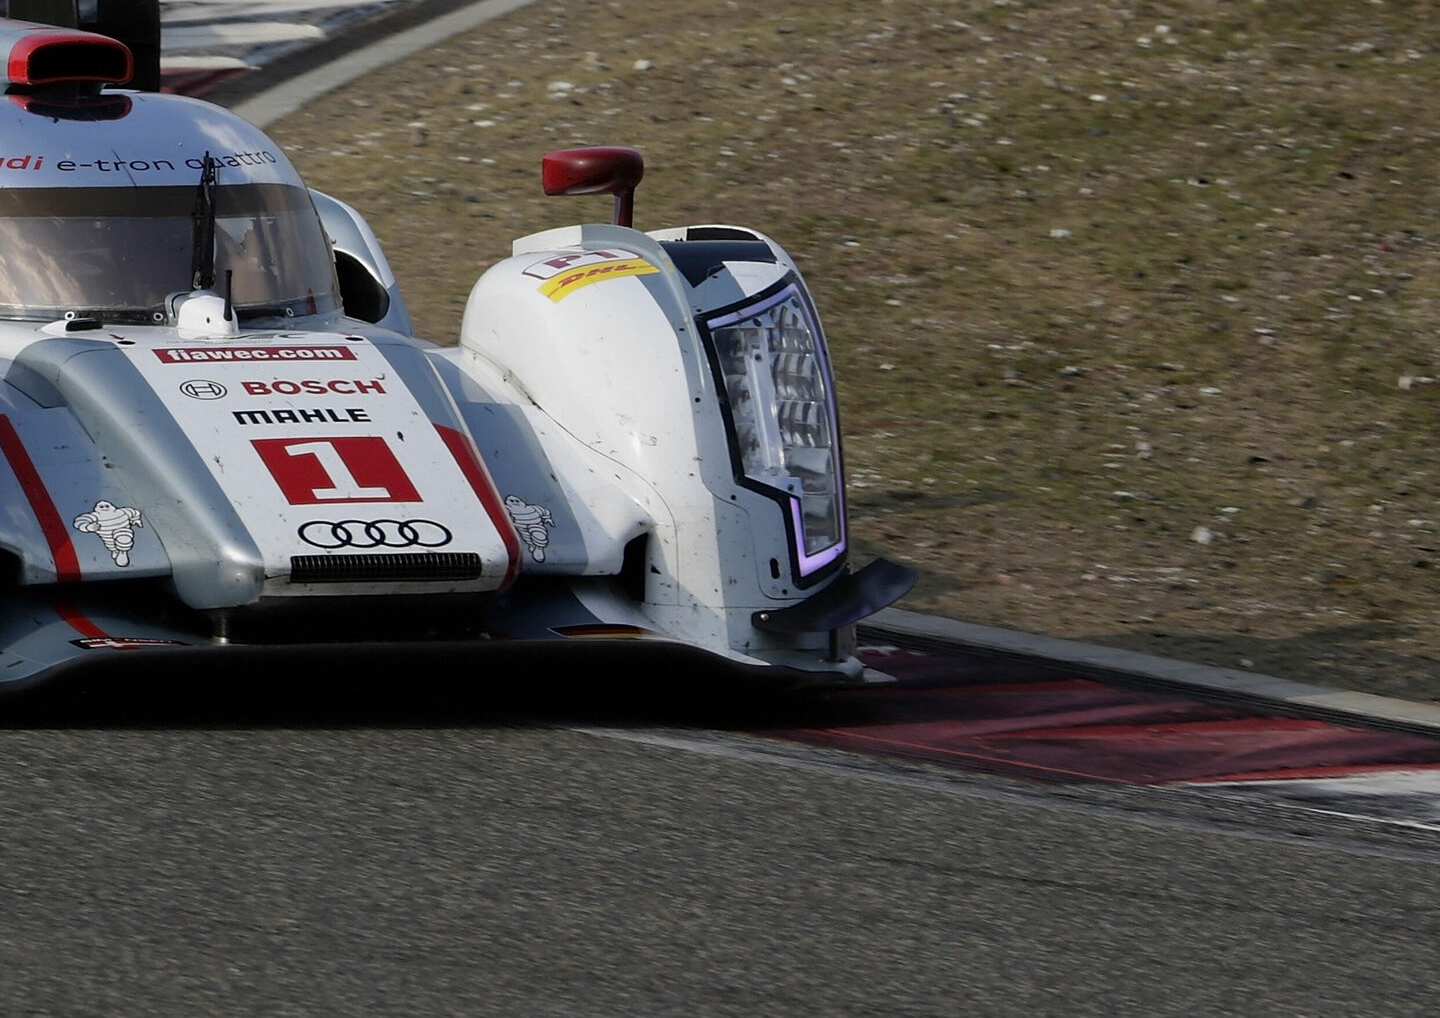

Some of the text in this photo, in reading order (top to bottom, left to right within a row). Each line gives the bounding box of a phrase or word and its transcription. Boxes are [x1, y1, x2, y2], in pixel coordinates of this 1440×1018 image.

[56, 158, 175, 173] e-tron
[558, 264, 637, 288] DHL
[167, 348, 343, 362] fiawec.com
[241, 380, 386, 396] BOSCH
[232, 408, 372, 425] MAHLE
[284, 441, 392, 500] 1
